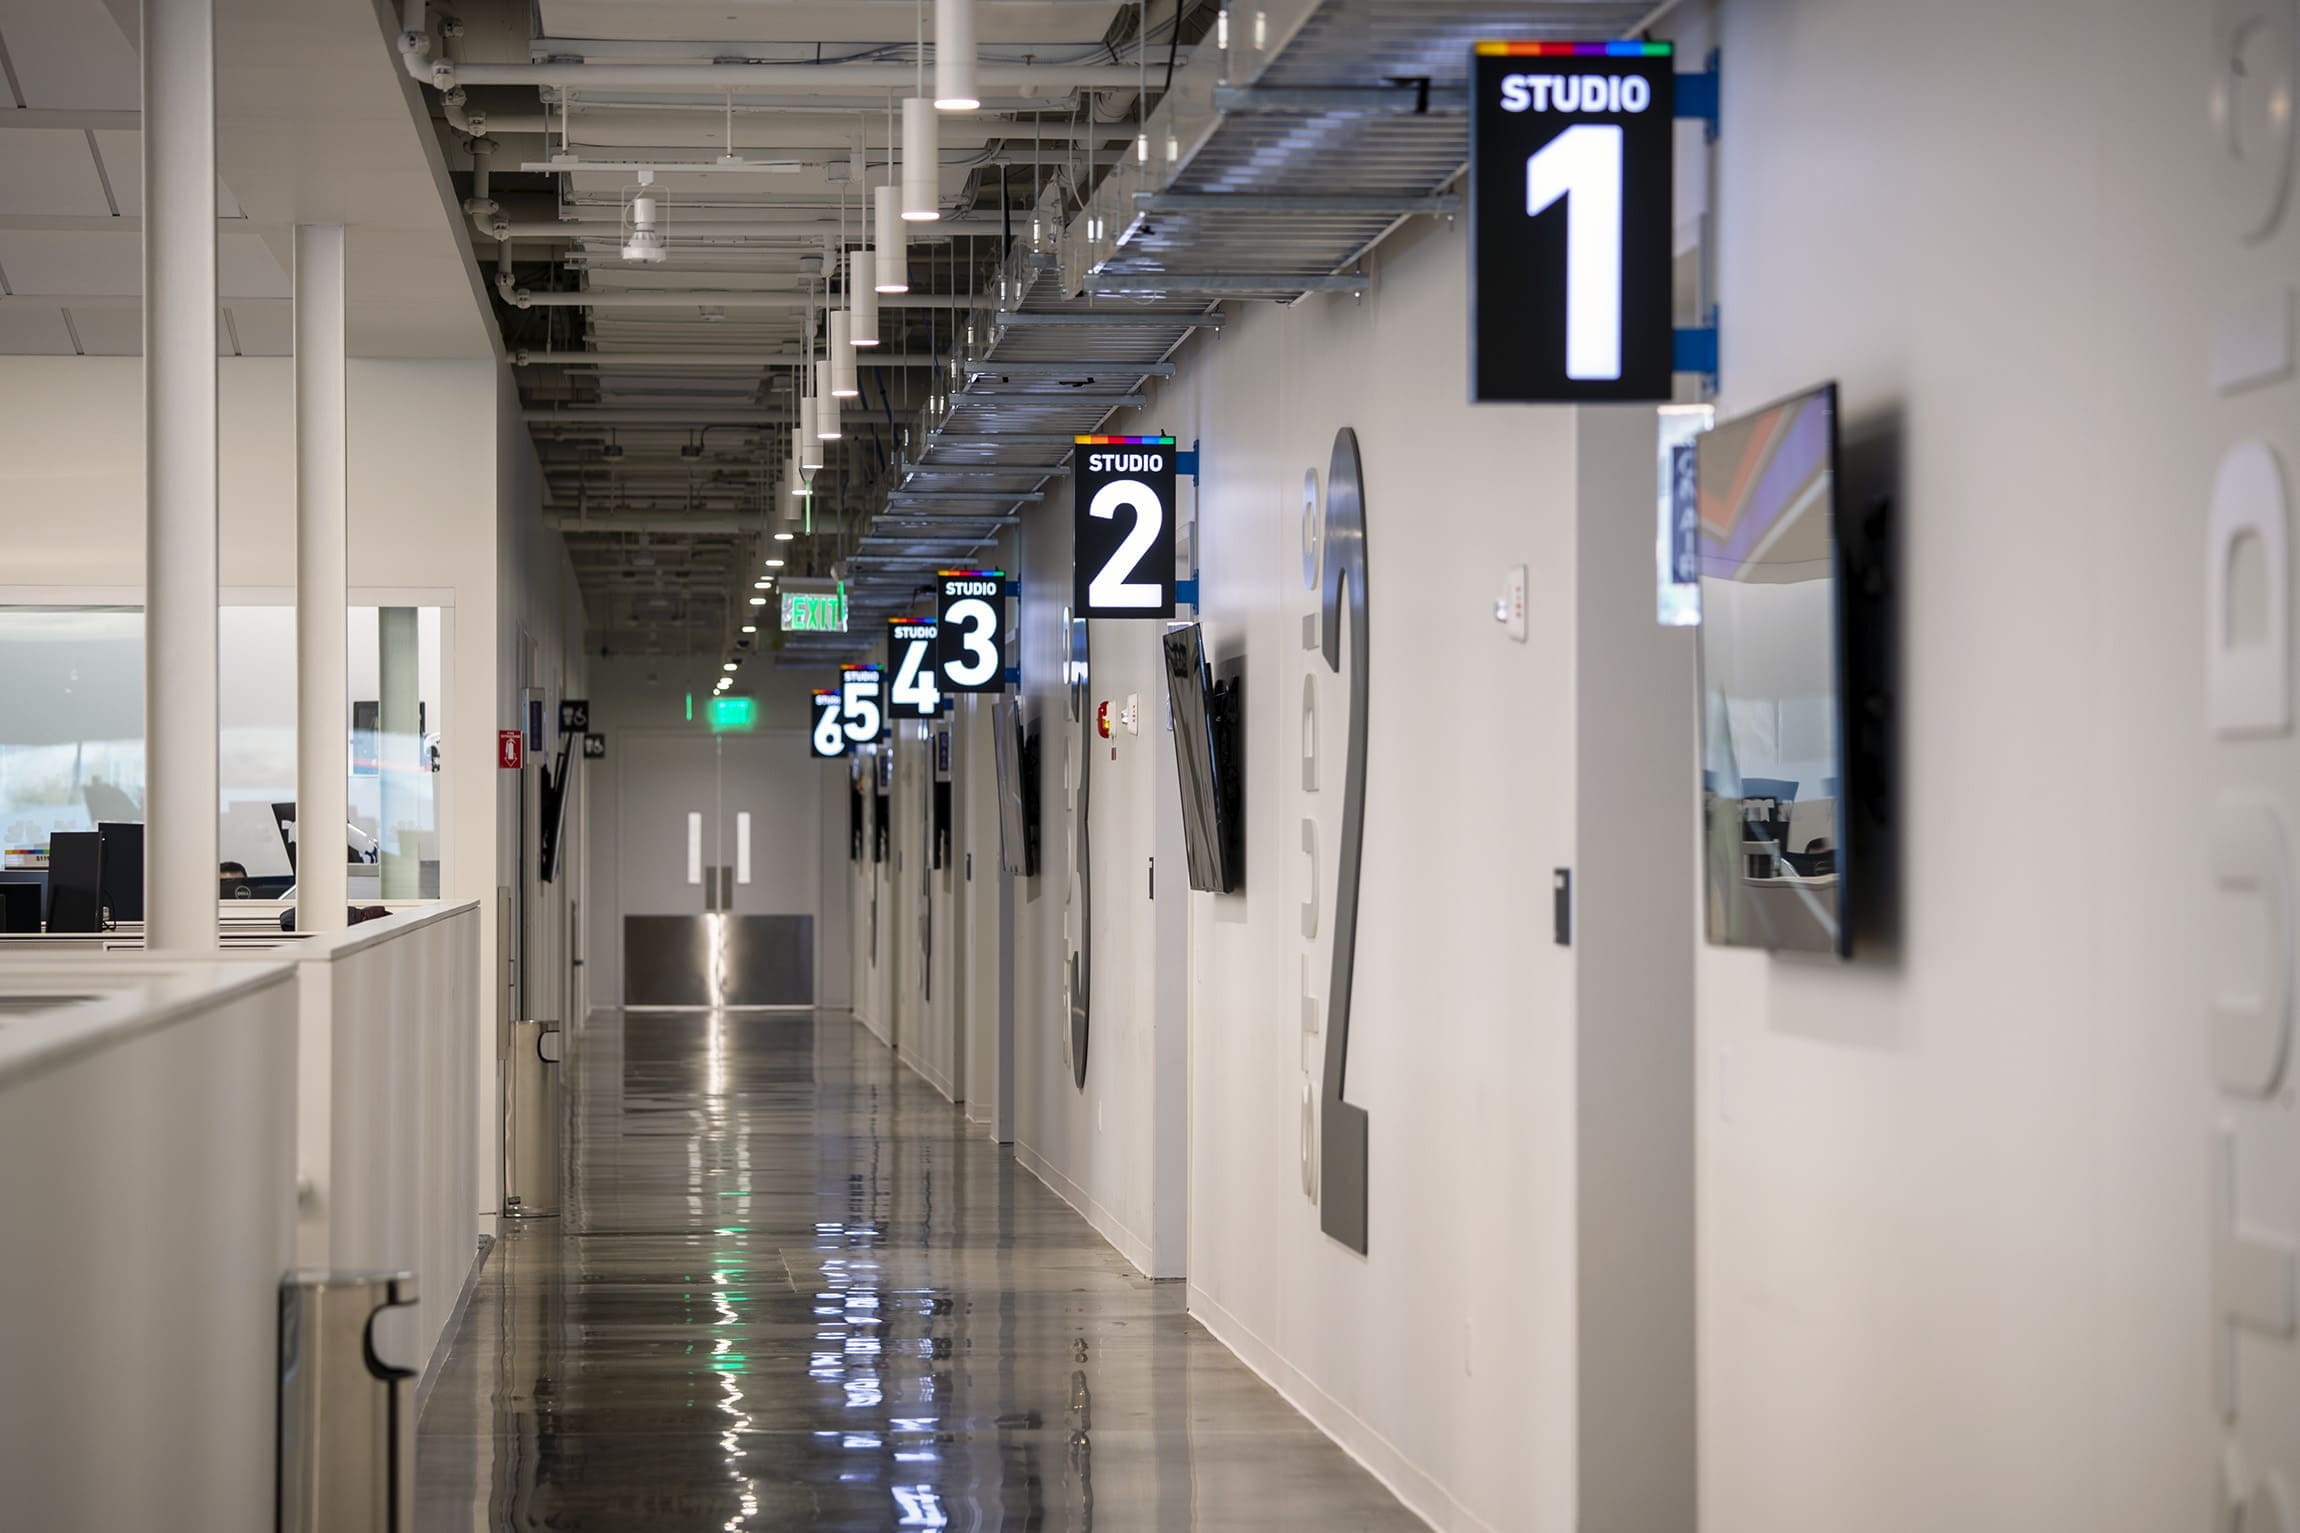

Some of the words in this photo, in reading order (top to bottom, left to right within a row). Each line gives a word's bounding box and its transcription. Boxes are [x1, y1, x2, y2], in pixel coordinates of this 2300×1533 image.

[1501, 74, 1651, 112] STUDIO
[1526, 124, 1623, 380] 1
[1089, 454, 1163, 472] STUDIO
[1088, 479, 1163, 608] 2
[792, 597, 838, 631] EXIT
[945, 581, 997, 596] STUDIO
[894, 626, 938, 639] STUDIO
[944, 598, 998, 686] 3
[892, 640, 940, 714] 4
[813, 705, 845, 756] 6
[843, 682, 880, 741] 5
